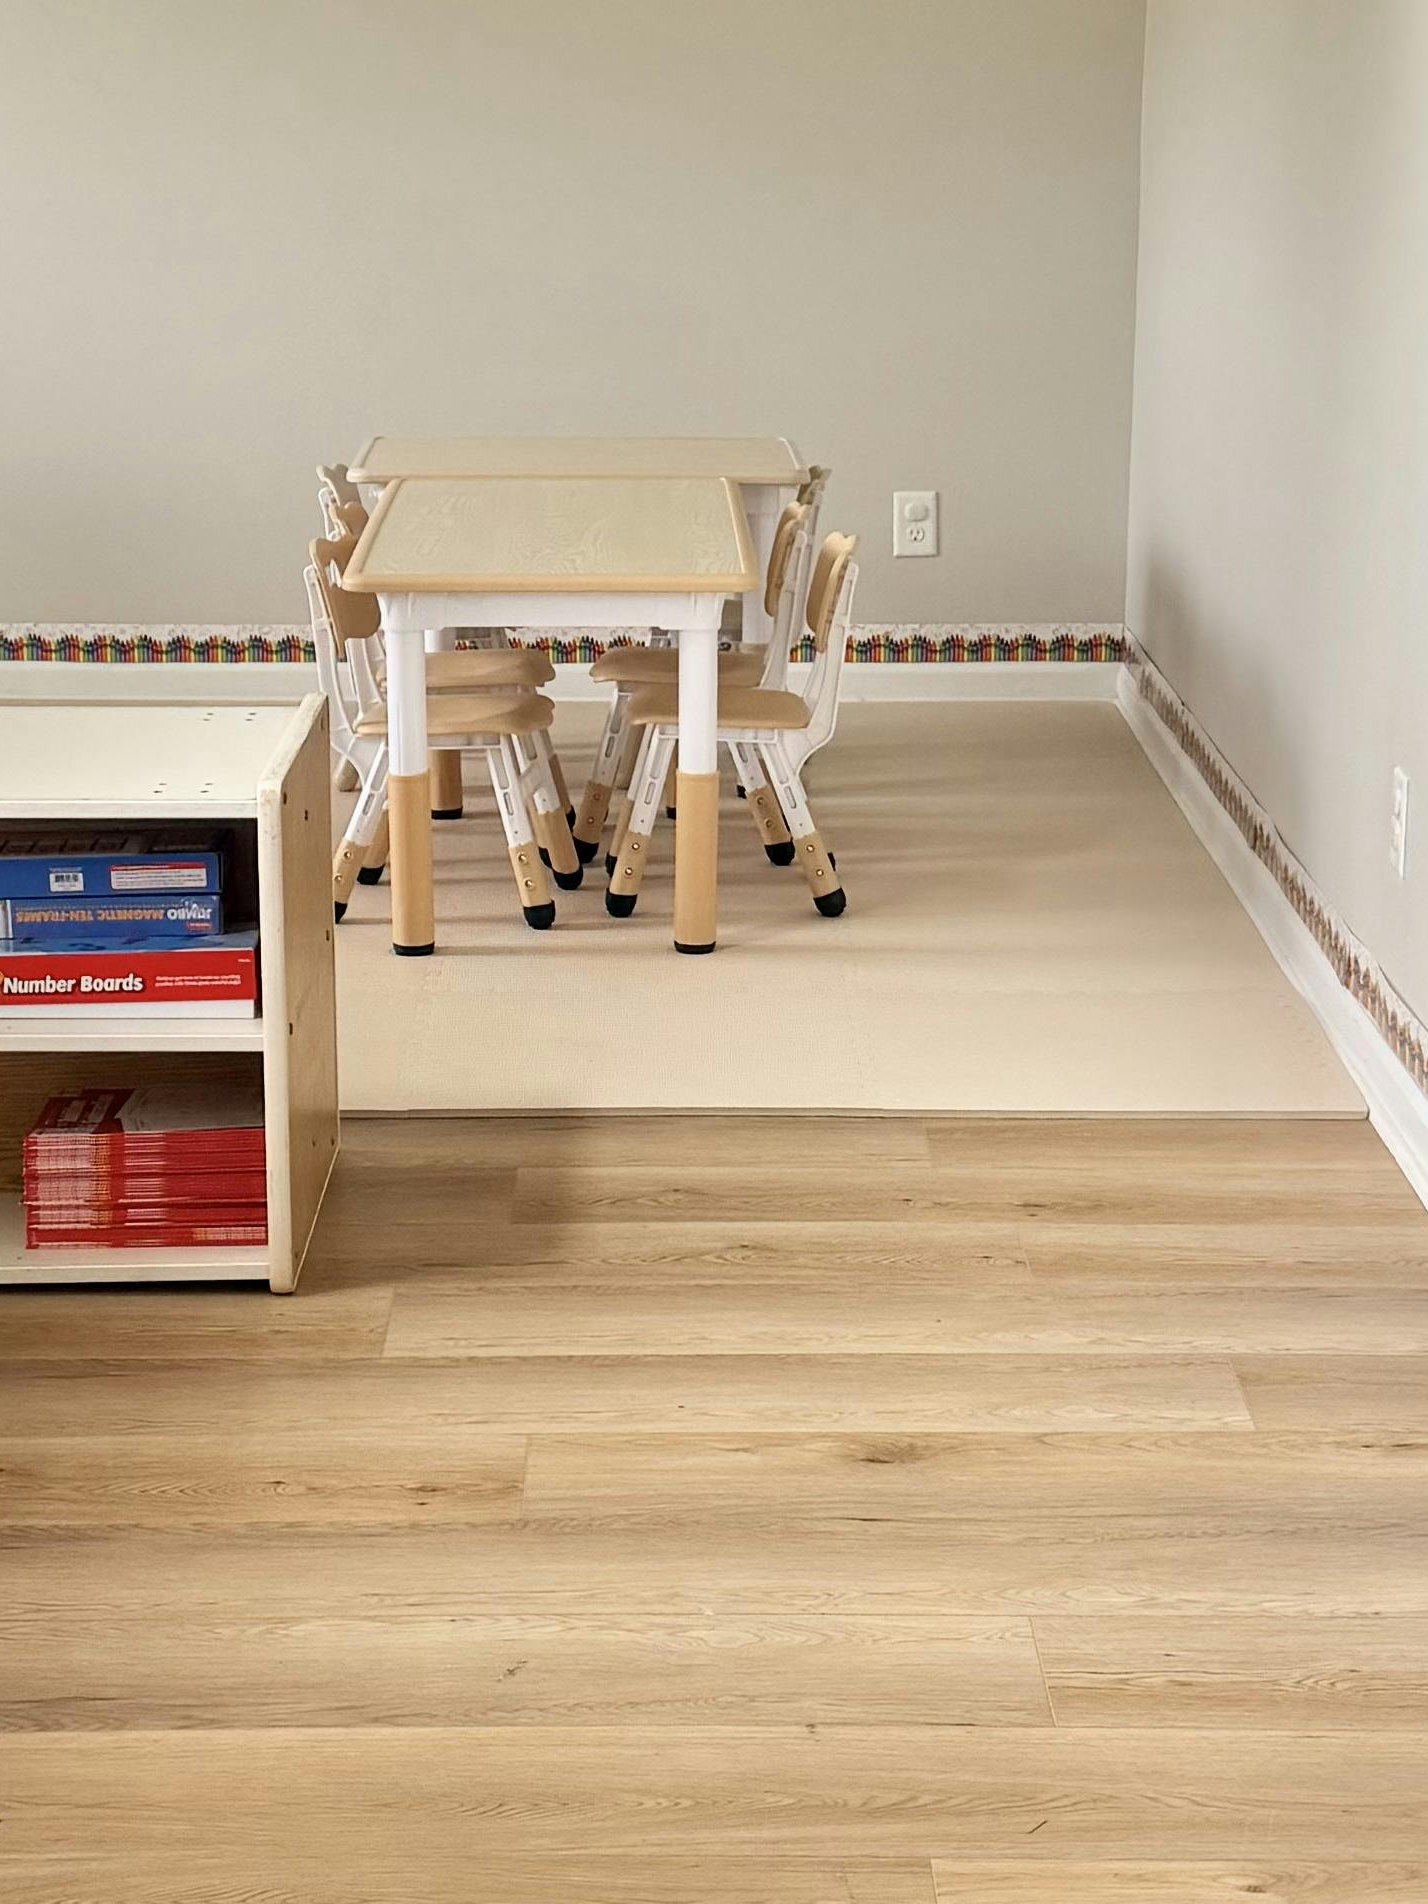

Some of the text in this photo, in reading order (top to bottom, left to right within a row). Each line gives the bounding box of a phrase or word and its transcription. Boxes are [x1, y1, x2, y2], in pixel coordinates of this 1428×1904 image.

[96, 909, 165, 921] MAGNETIC
[2, 976, 77, 994] Number
[79, 972, 143, 993] Boards
